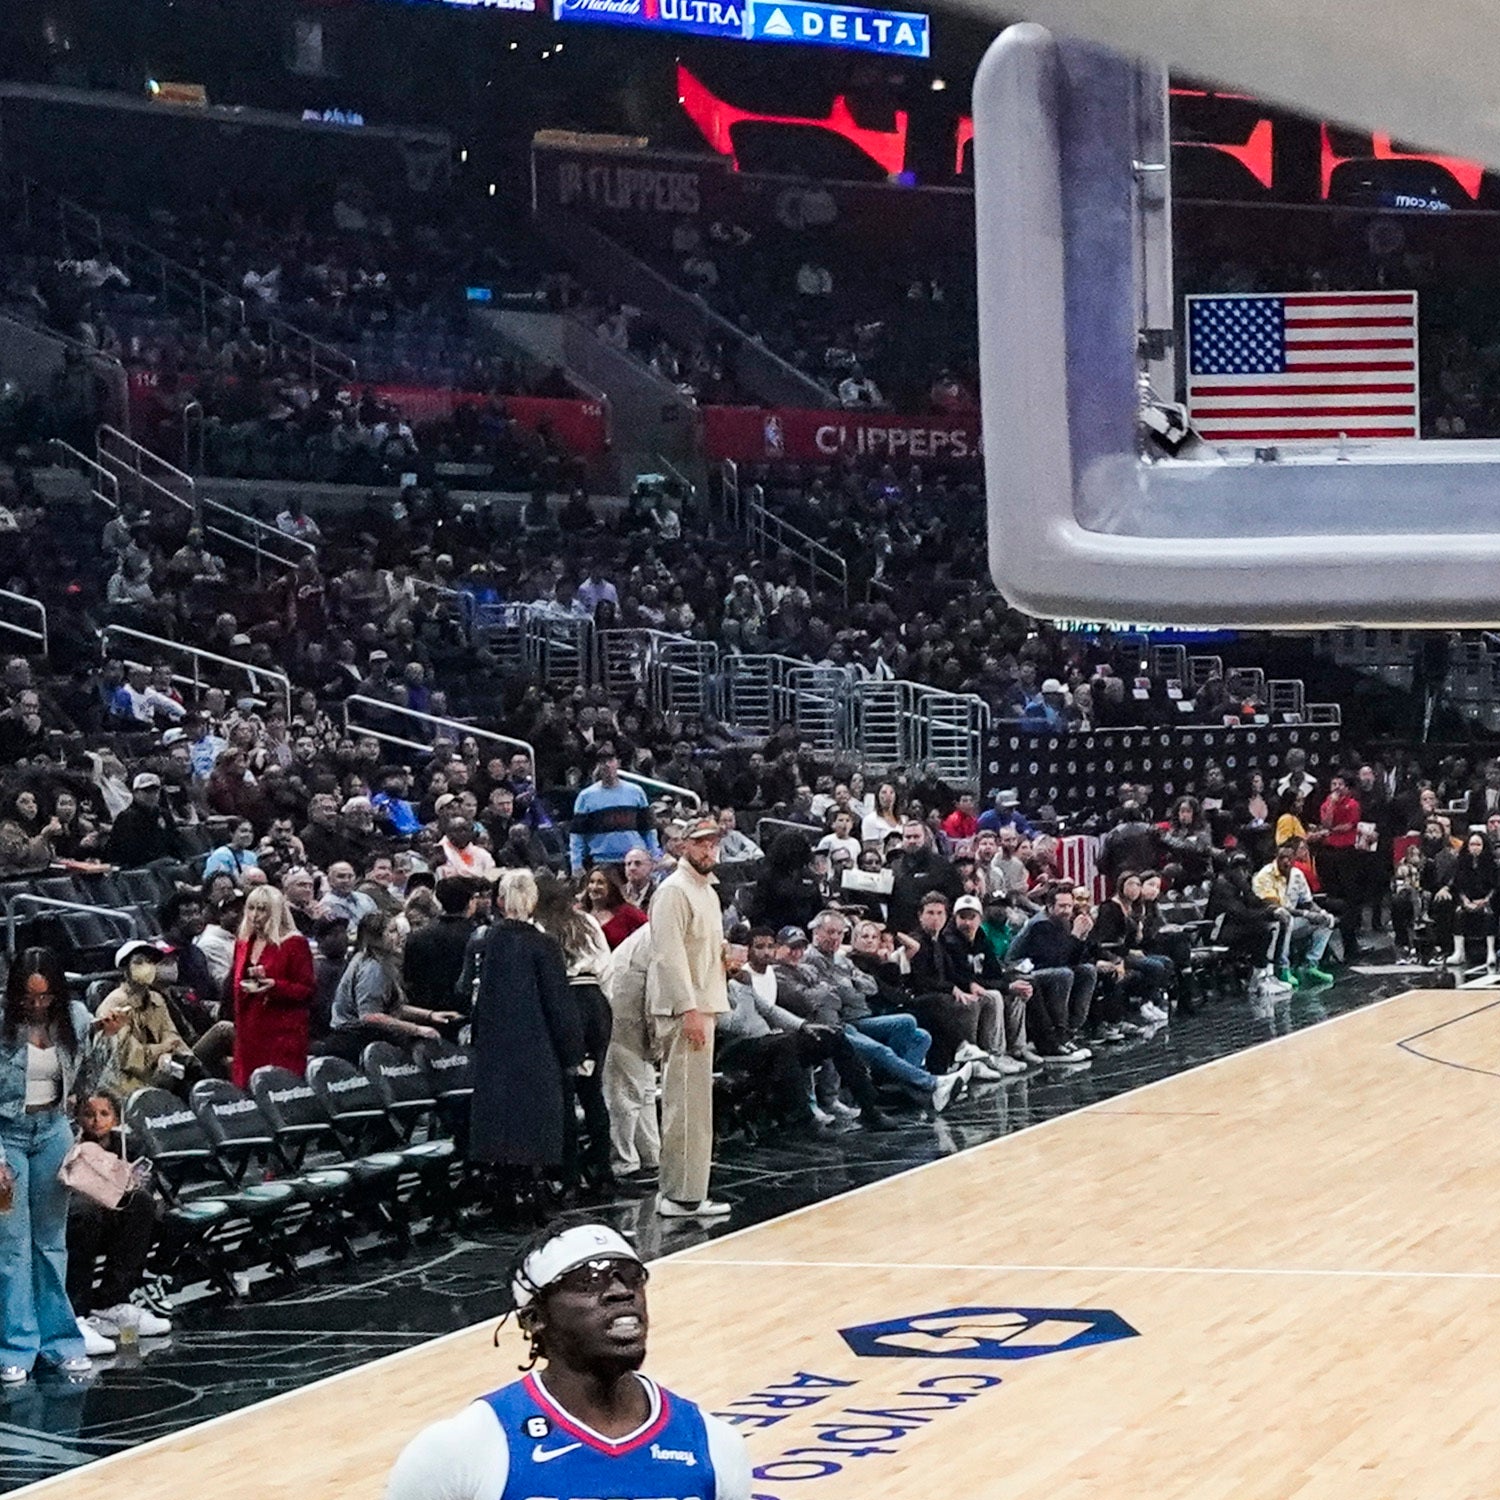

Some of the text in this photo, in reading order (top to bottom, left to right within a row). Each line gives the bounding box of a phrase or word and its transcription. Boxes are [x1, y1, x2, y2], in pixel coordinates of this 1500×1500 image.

[661, 0, 740, 26] ULTRA
[803, 12, 916, 46] DELTA
[527, 1417, 548, 1438] 6
[651, 1443, 698, 1466] honey
